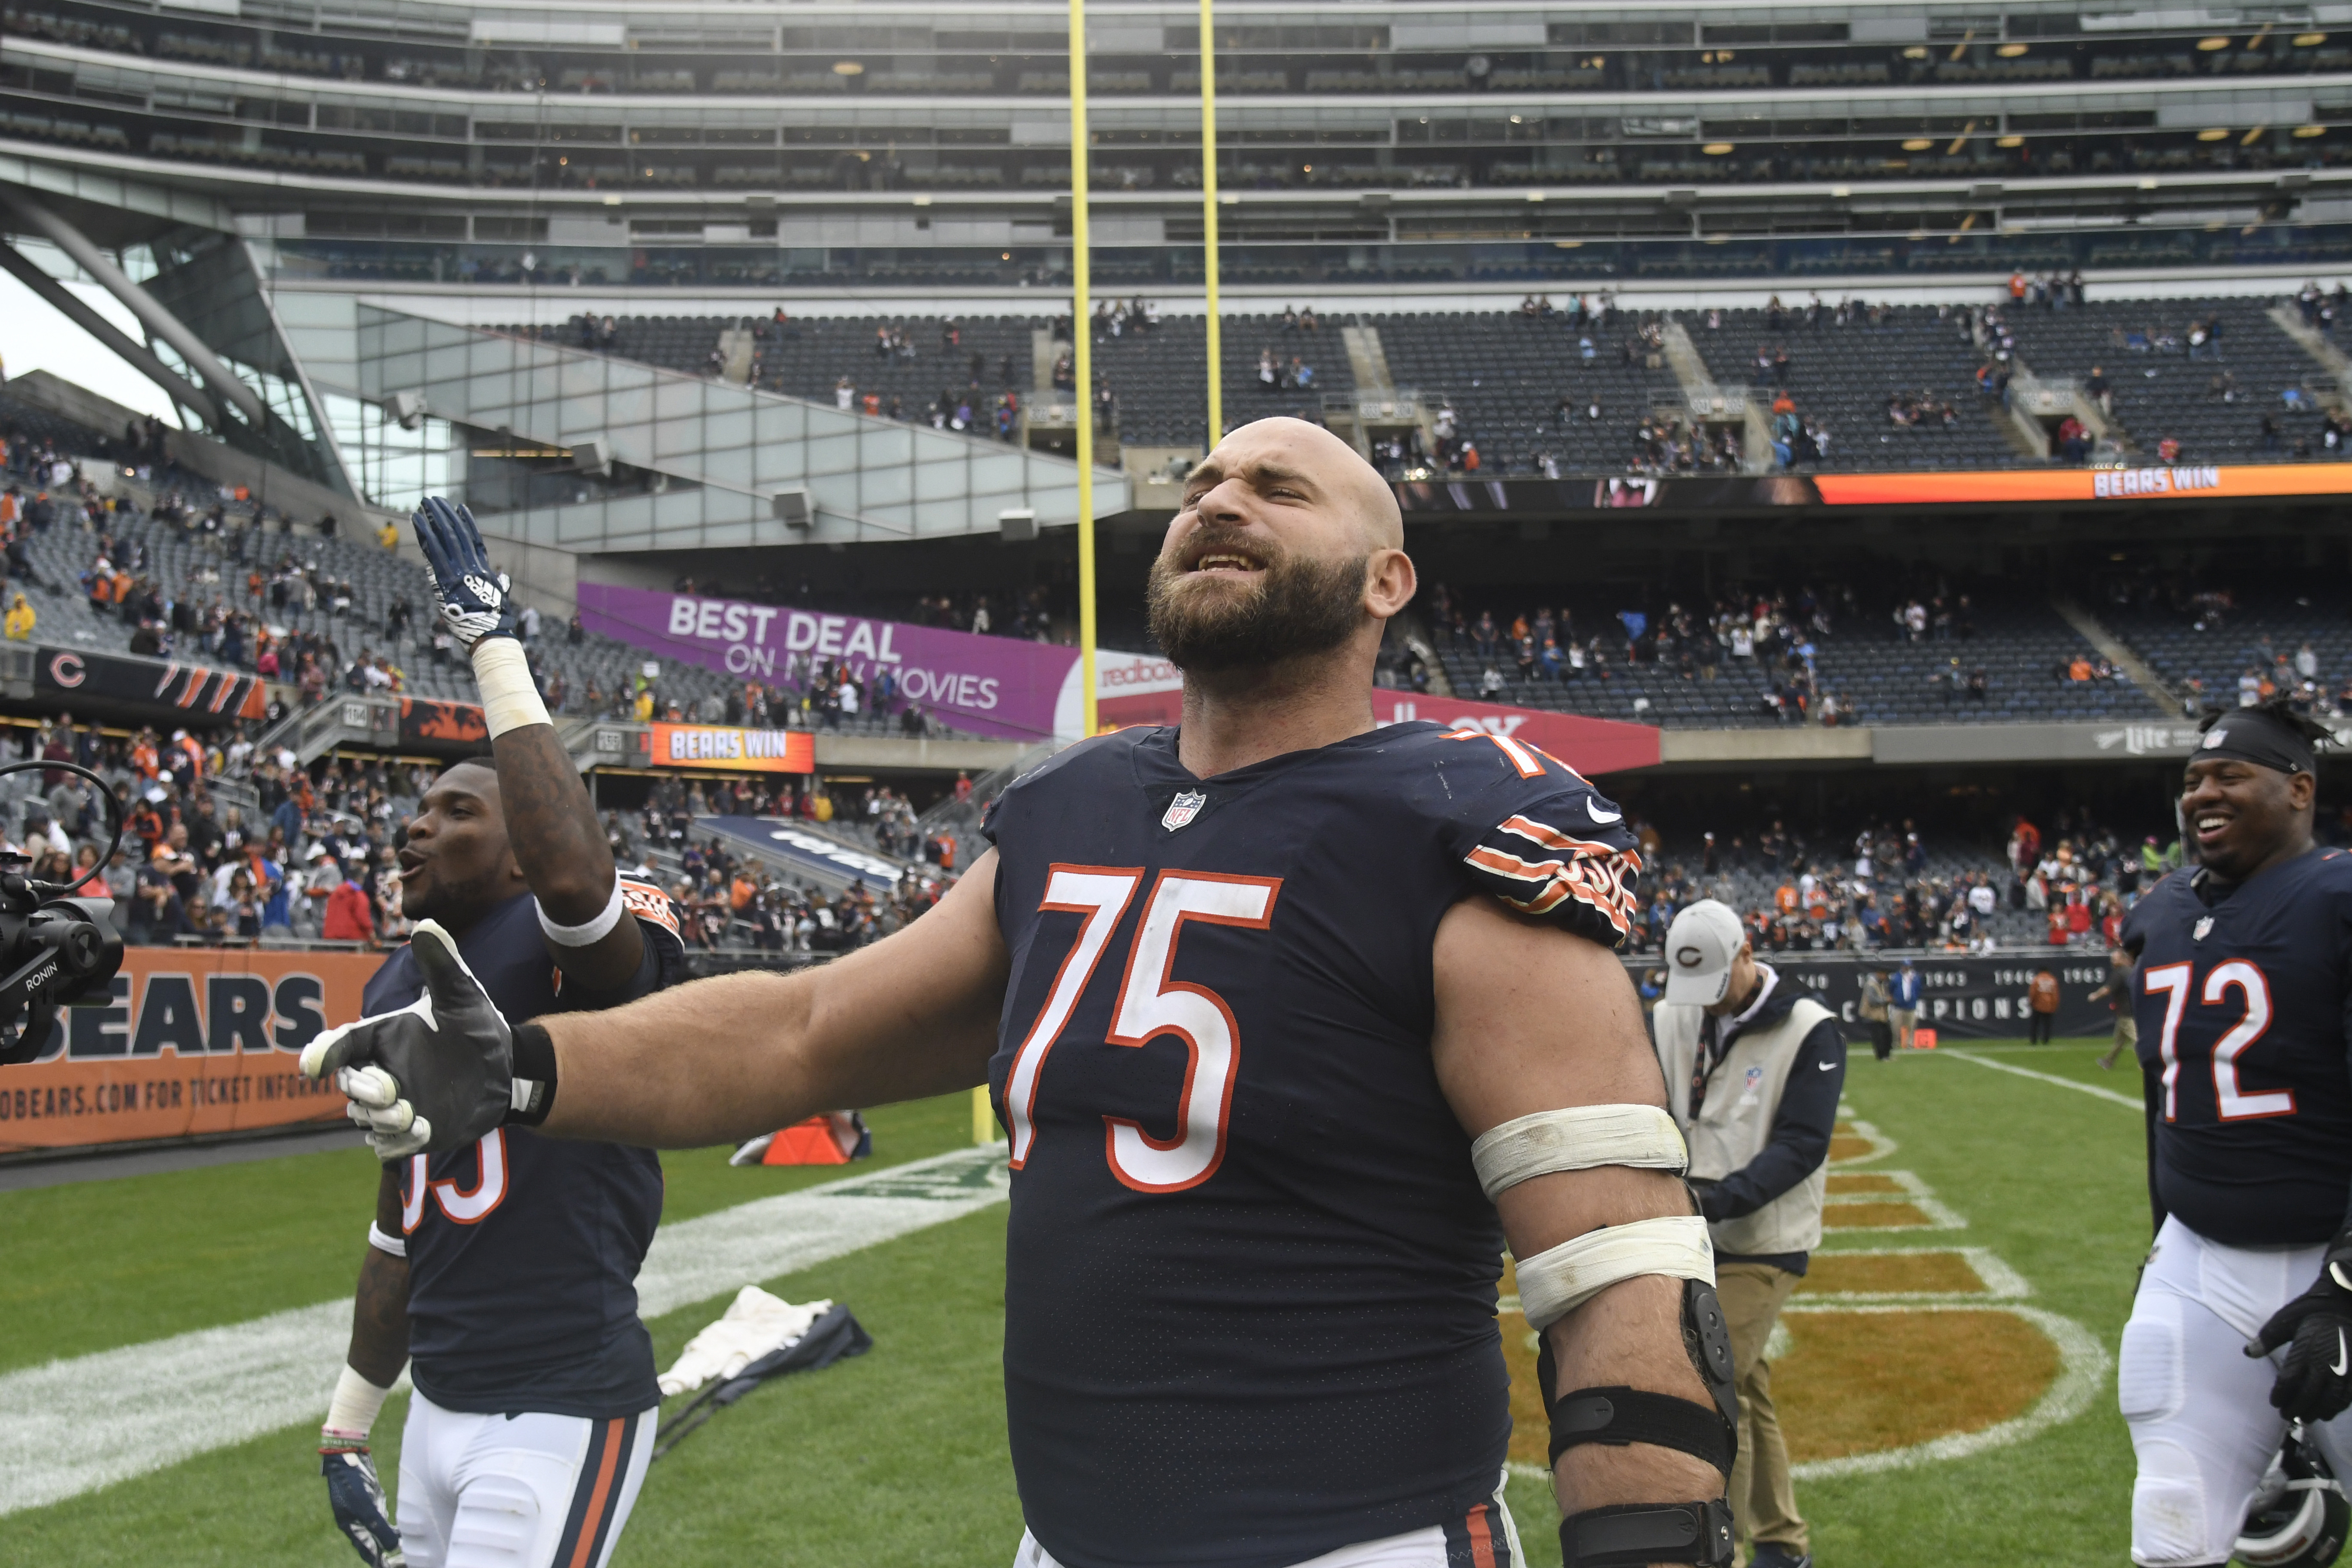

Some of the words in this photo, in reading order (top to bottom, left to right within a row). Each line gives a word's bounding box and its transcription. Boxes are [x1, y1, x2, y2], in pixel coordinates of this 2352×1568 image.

[2094, 467, 2170, 497] BEARS
[2171, 465, 2219, 490] WIN
[668, 598, 778, 645] BEST
[785, 611, 902, 664] DEAL
[724, 644, 776, 678] ON
[1102, 659, 1182, 687] redbox
[670, 730, 741, 759] BEARS
[744, 729, 787, 758] WIN
[1167, 808, 1191, 824] NFL
[1676, 946, 1702, 968] C
[25, 961, 58, 992] RONIN
[1925, 970, 1967, 988] 1943
[2063, 966, 2106, 984] 1963
[1003, 862, 1285, 1194] 75
[2144, 957, 2298, 1123] 72
[145, 1080, 182, 1109] FOR
[191, 1076, 250, 1105] TICKET
